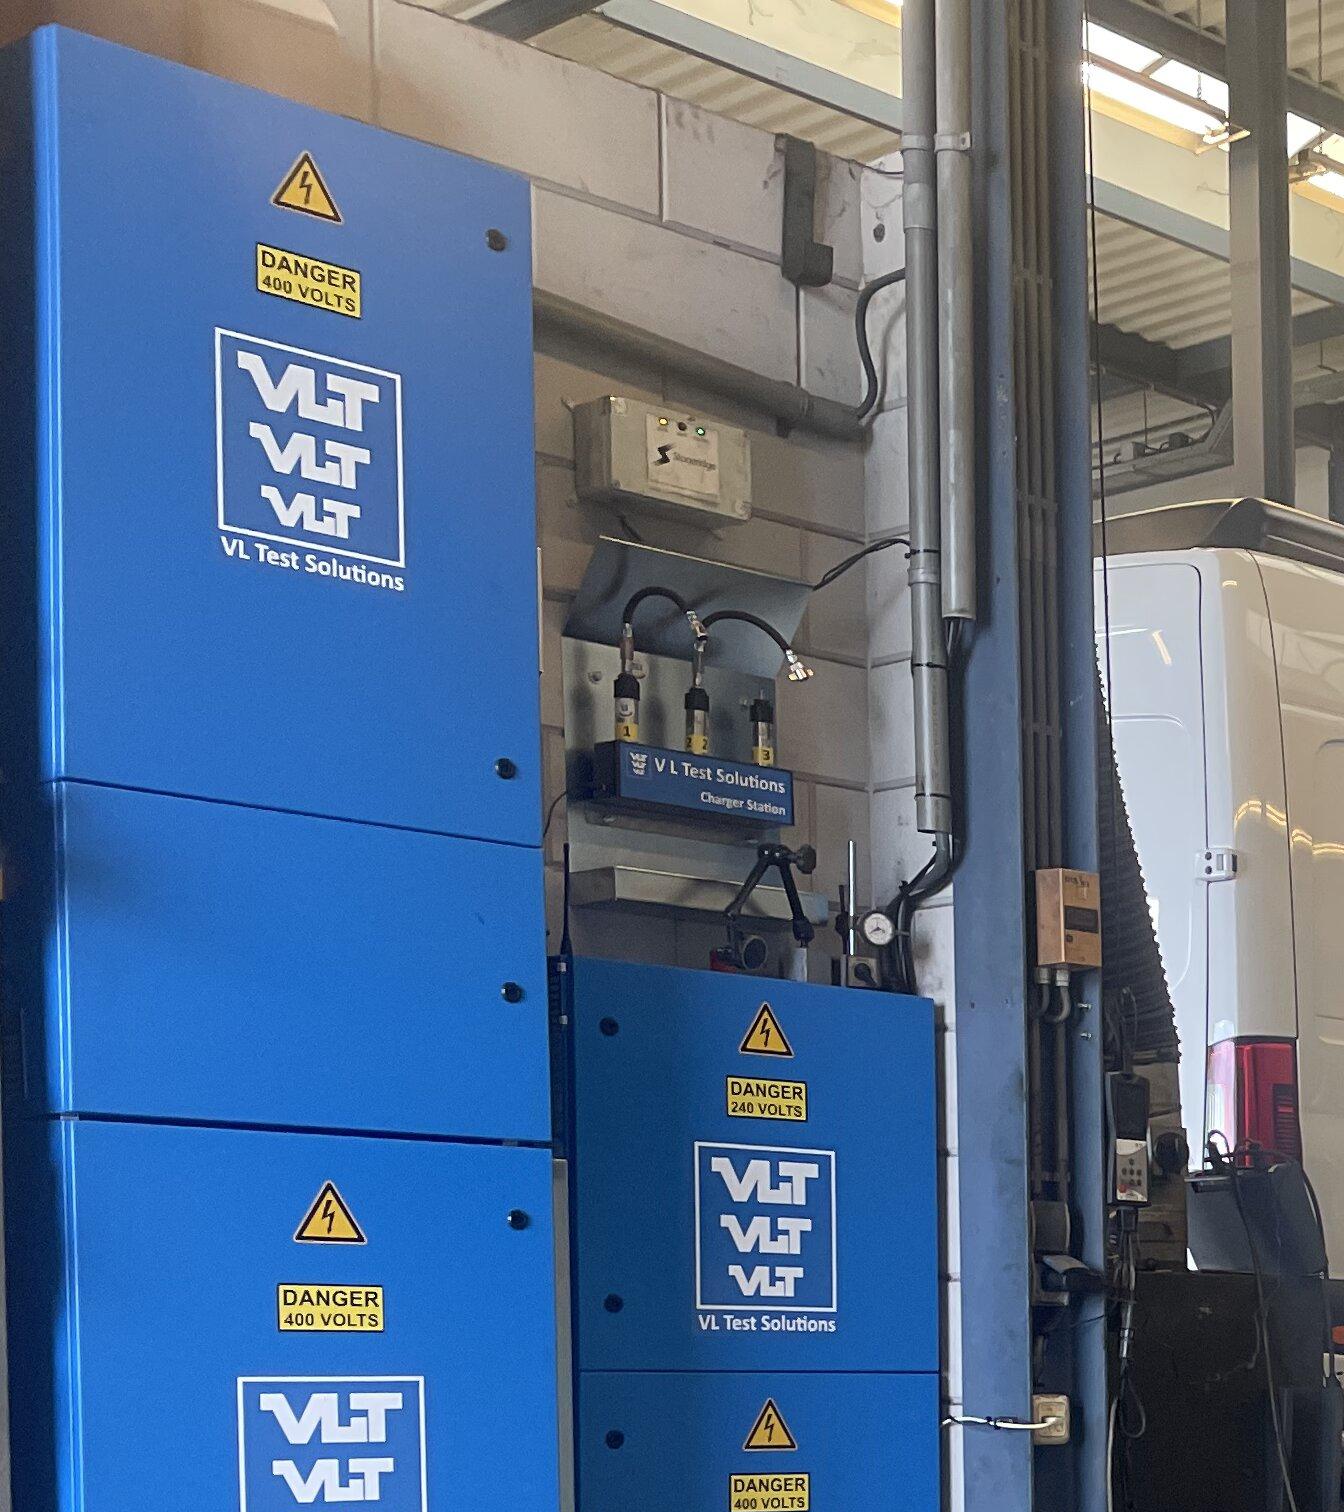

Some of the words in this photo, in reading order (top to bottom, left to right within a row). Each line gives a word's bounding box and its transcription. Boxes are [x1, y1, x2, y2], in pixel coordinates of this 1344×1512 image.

[261, 250, 356, 293] DANGER
[262, 275, 292, 294] 400
[298, 283, 356, 312] VOLTS
[237, 350, 380, 432] VLT
[249, 422, 371, 490] VLT
[261, 485, 360, 539] VLT
[220, 536, 250, 560] VL
[254, 542, 299, 570] Test
[304, 554, 405, 591] Solutions
[623, 726, 631, 737] 1
[762, 750, 770, 761] 3
[654, 757, 666, 773] V
[670, 760, 678, 775] L
[681, 762, 713, 781] Test
[716, 768, 786, 794] Solutions
[700, 791, 744, 809] Charger
[747, 797, 786, 816] Station
[731, 1081, 804, 1101] DANGER
[731, 1101, 753, 1114] 240
[758, 1103, 803, 1118] VOLTS
[711, 1156, 819, 1206] VLT
[720, 1214, 812, 1255] VLT
[728, 1265, 804, 1297] VLT
[283, 1289, 380, 1308] DANGER
[284, 1313, 314, 1326] 400
[320, 1313, 379, 1328] VOLTS
[698, 1314, 719, 1331] VL
[723, 1314, 757, 1331] Test
[760, 1315, 836, 1333] Solutions
[259, 1392, 403, 1445] VLT
[272, 1457, 394, 1503] VLT
[733, 1477, 806, 1493] DANGER
[734, 1498, 757, 1510] 400
[761, 1496, 805, 1509] VOLTS
